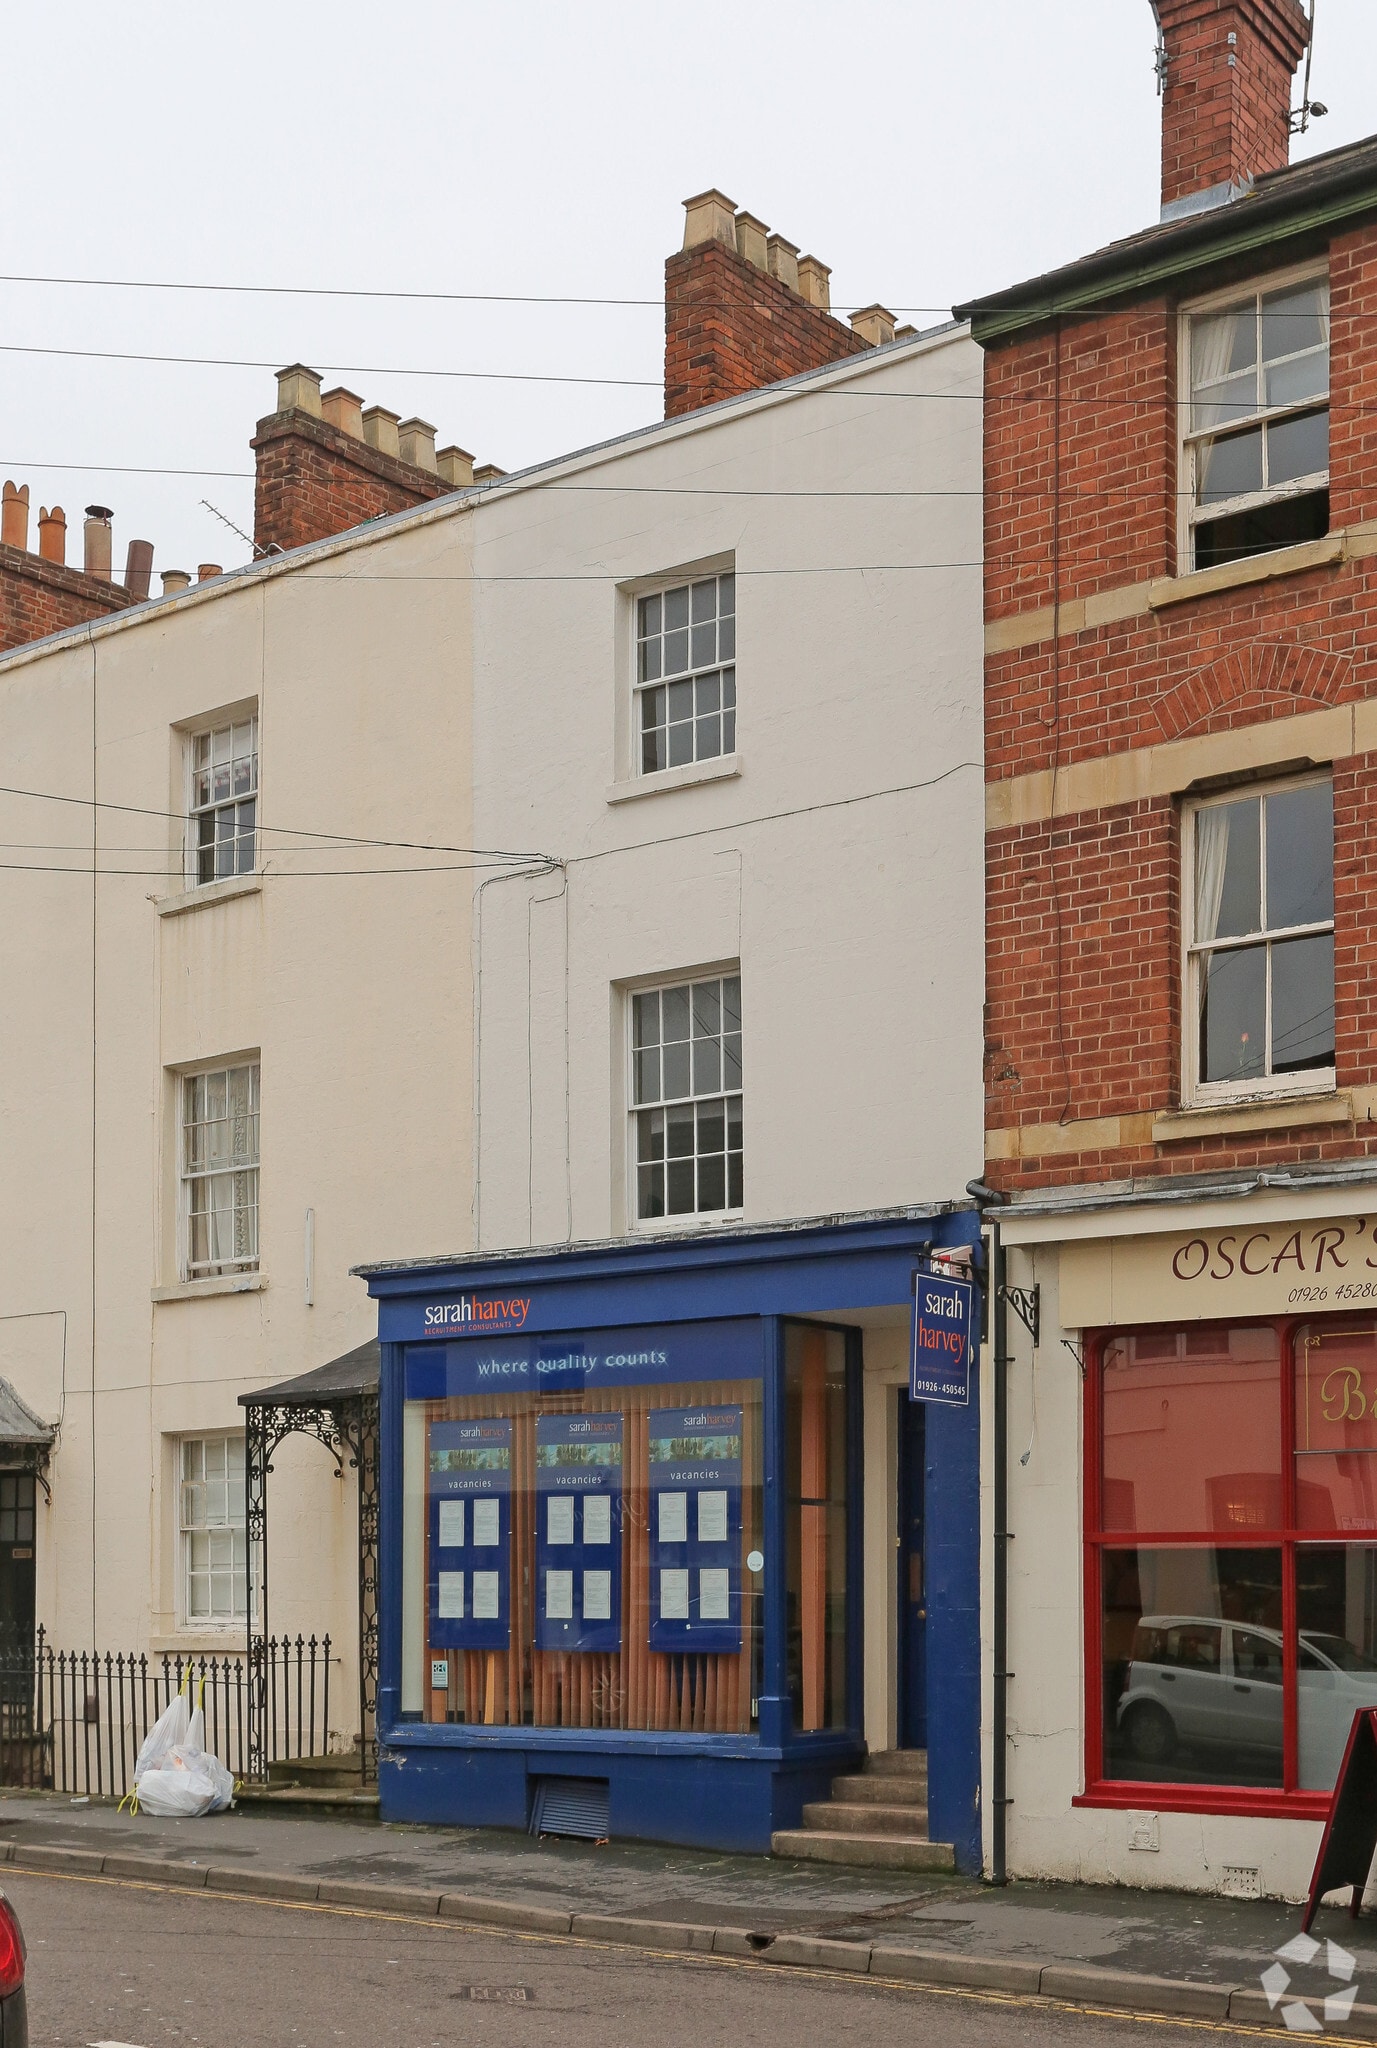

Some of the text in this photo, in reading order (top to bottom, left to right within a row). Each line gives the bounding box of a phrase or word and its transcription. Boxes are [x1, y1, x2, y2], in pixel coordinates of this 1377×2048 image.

[1288, 1286, 1328, 1303] 01926
[925, 1290, 963, 1319] sarah
[424, 1321, 512, 1335] RECRUITMENT CONSULTANTS
[919, 1318, 966, 1364] harvey
[478, 1350, 666, 1375] where quality counts
[556, 1474, 602, 1485] vacancies
[670, 1469, 719, 1481] vacancies
[448, 1478, 492, 1489] vacancies
